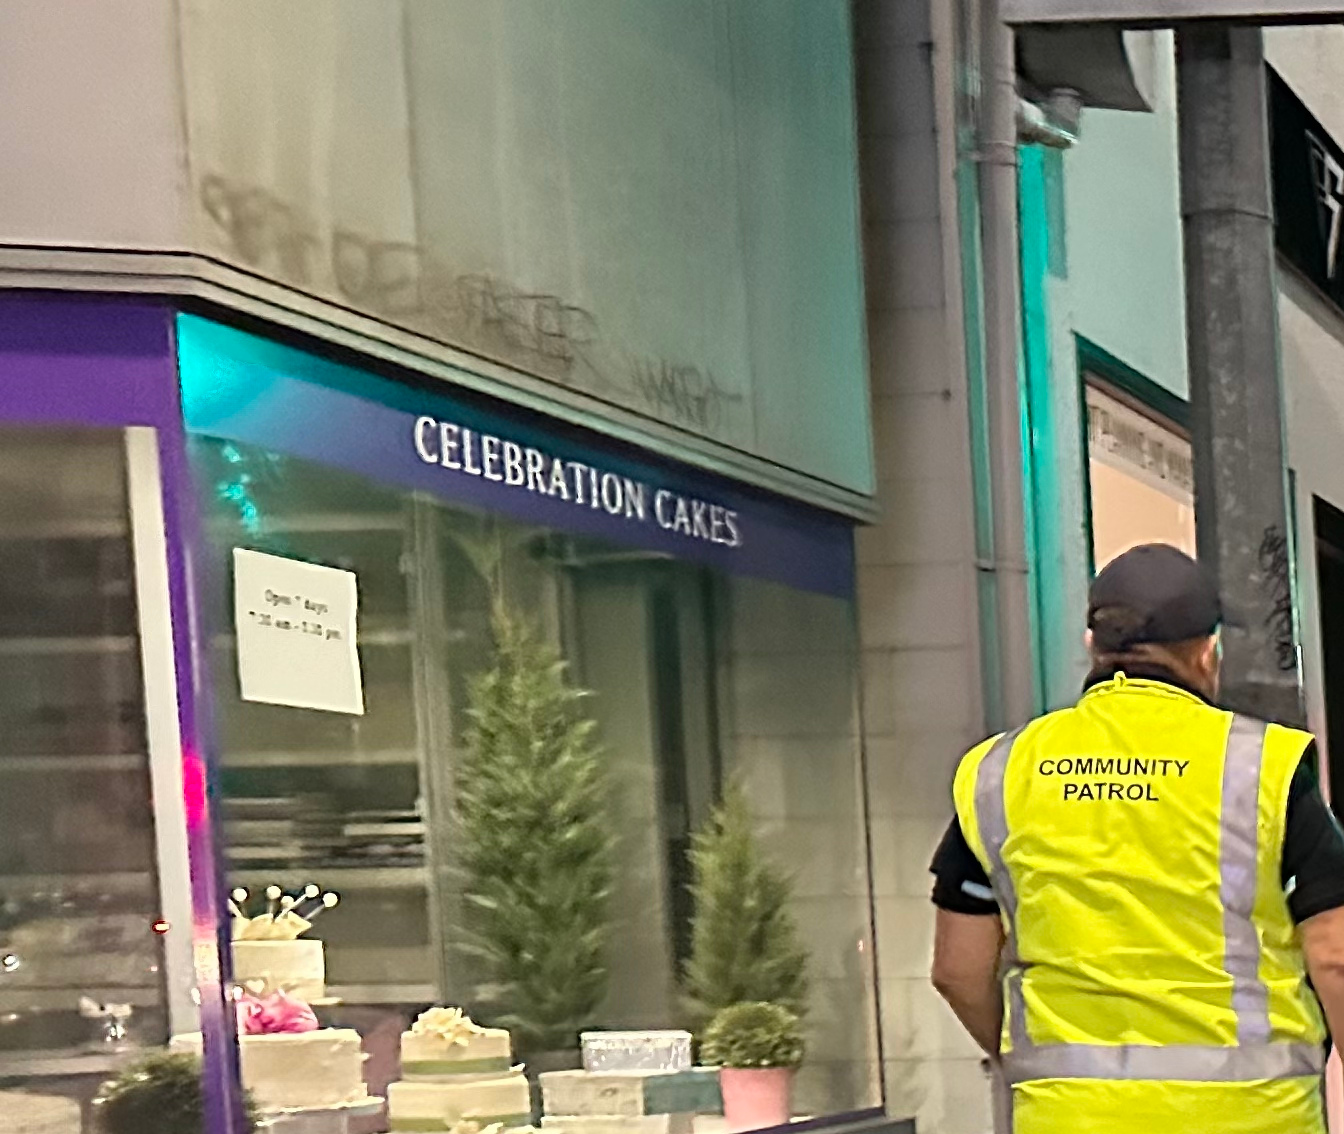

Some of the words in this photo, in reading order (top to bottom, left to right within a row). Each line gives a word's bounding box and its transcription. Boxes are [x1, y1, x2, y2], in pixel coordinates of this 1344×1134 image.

[413, 415, 646, 521] CELEBRATION
[654, 489, 744, 548] CAKES
[1038, 757, 1190, 777] COMMUNITY
[1063, 781, 1159, 801] PATROL
